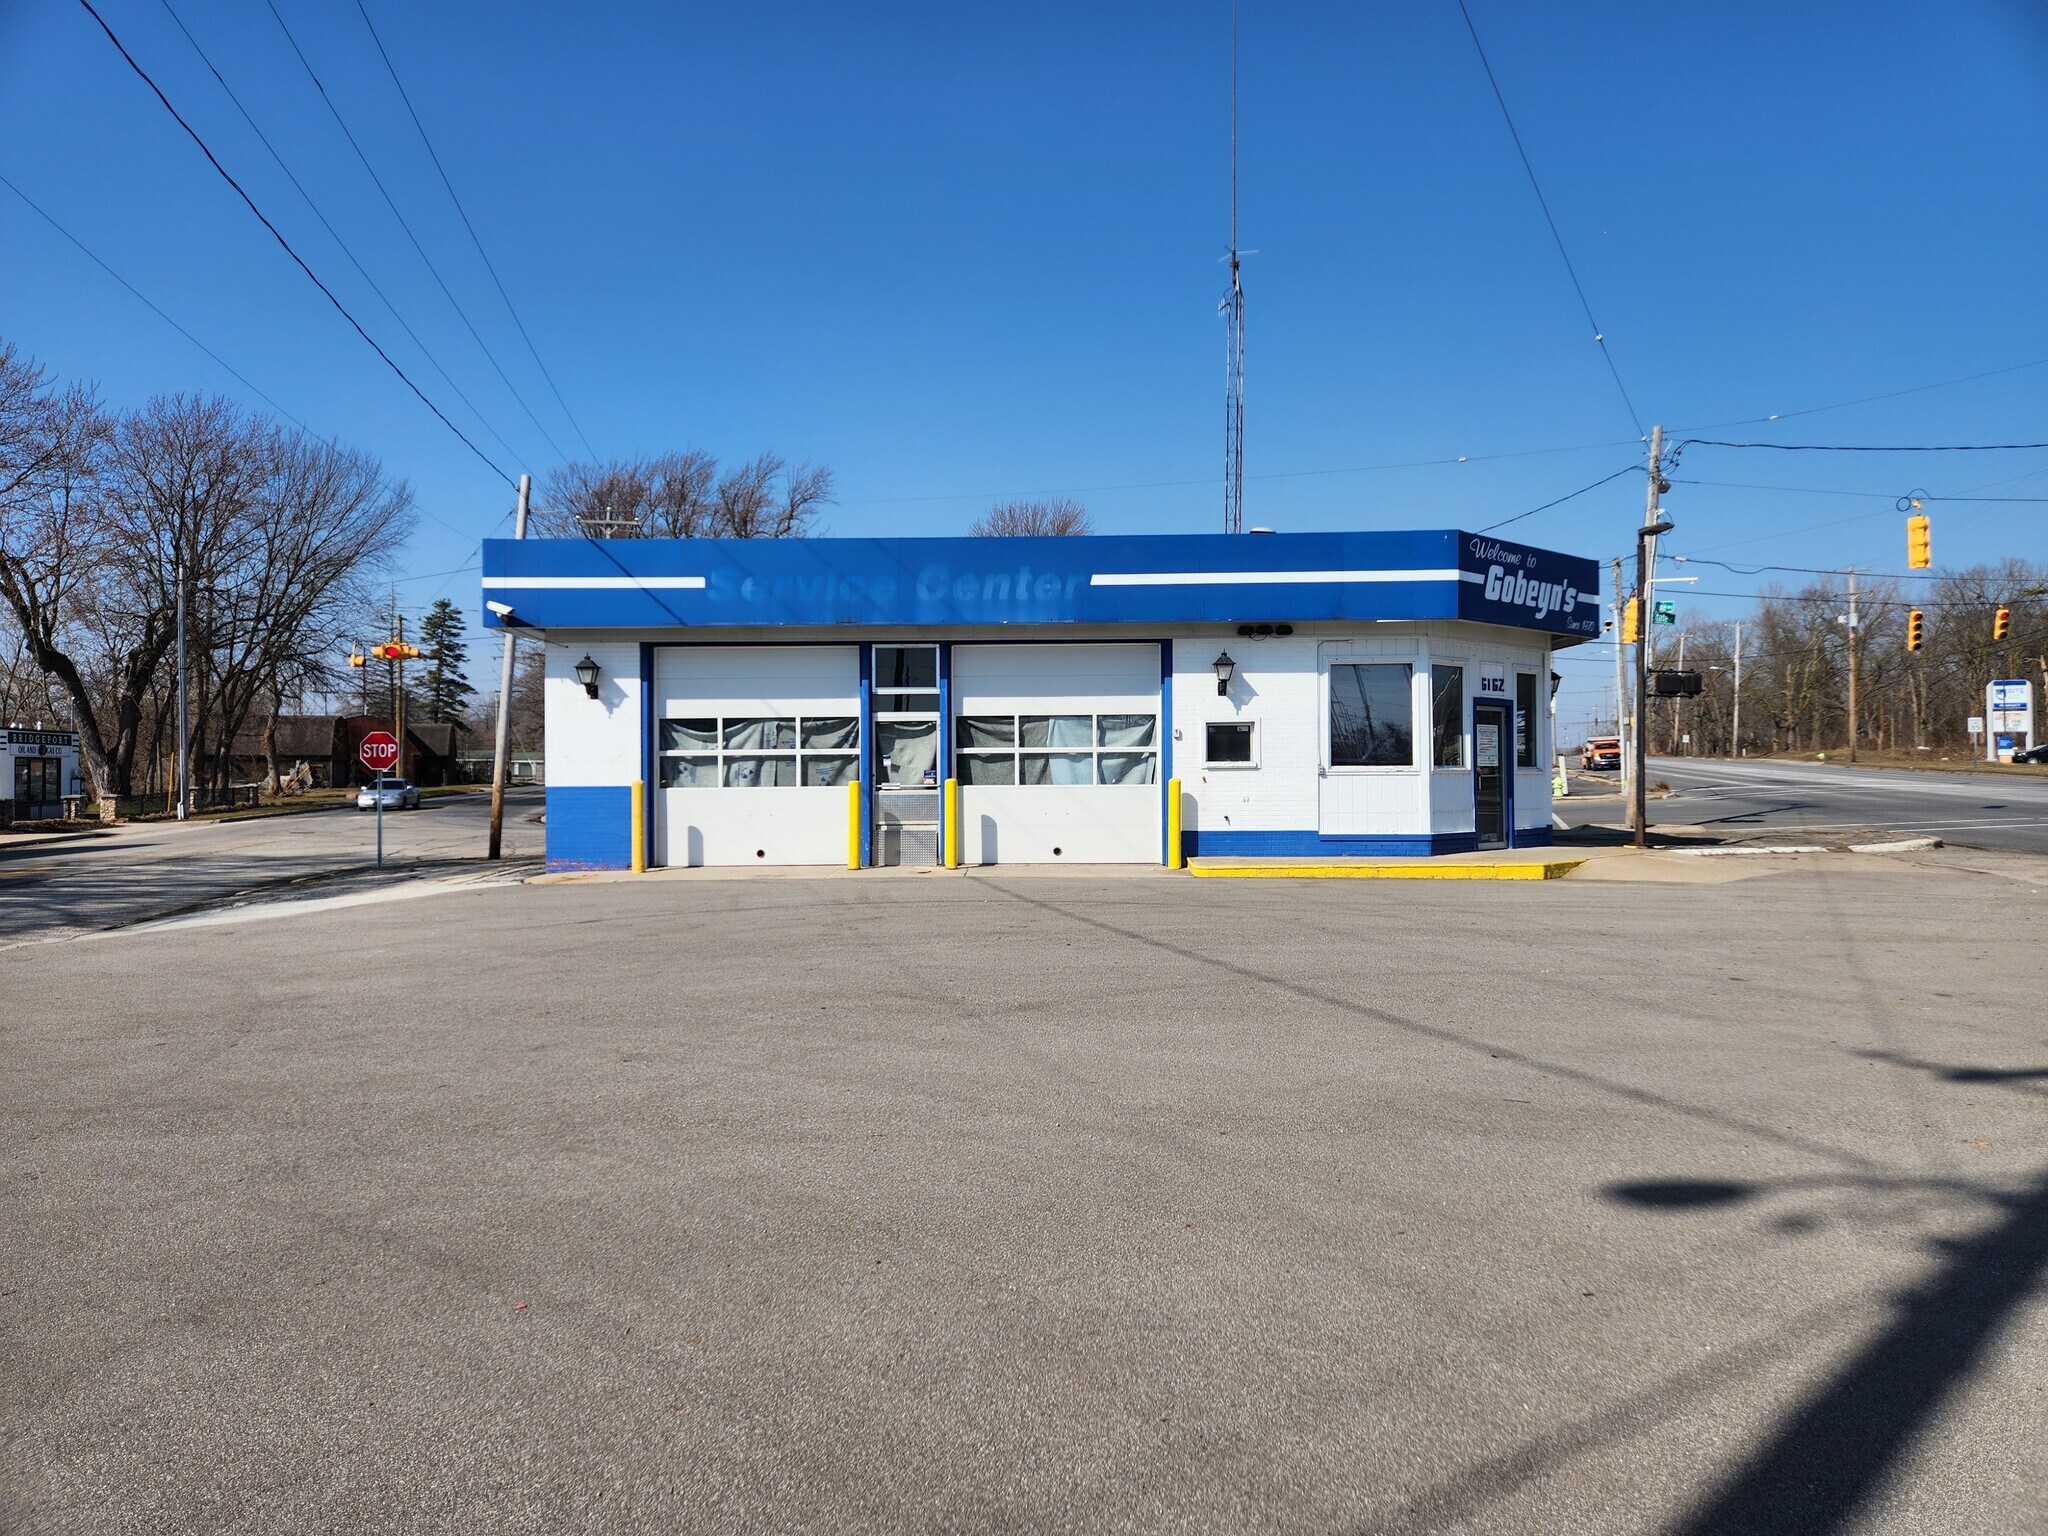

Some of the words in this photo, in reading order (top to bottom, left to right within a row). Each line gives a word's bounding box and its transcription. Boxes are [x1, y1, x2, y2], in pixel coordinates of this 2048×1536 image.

[1469, 538, 1521, 565] Welcome
[1526, 553, 1537, 568] to
[706, 566, 897, 602] Service
[916, 564, 1084, 601] Center
[1484, 564, 1578, 620] Gobeyn's
[12, 734, 68, 744] BRIDGEPORT
[26, 746, 37, 754] AND
[363, 743, 397, 758] STOP
